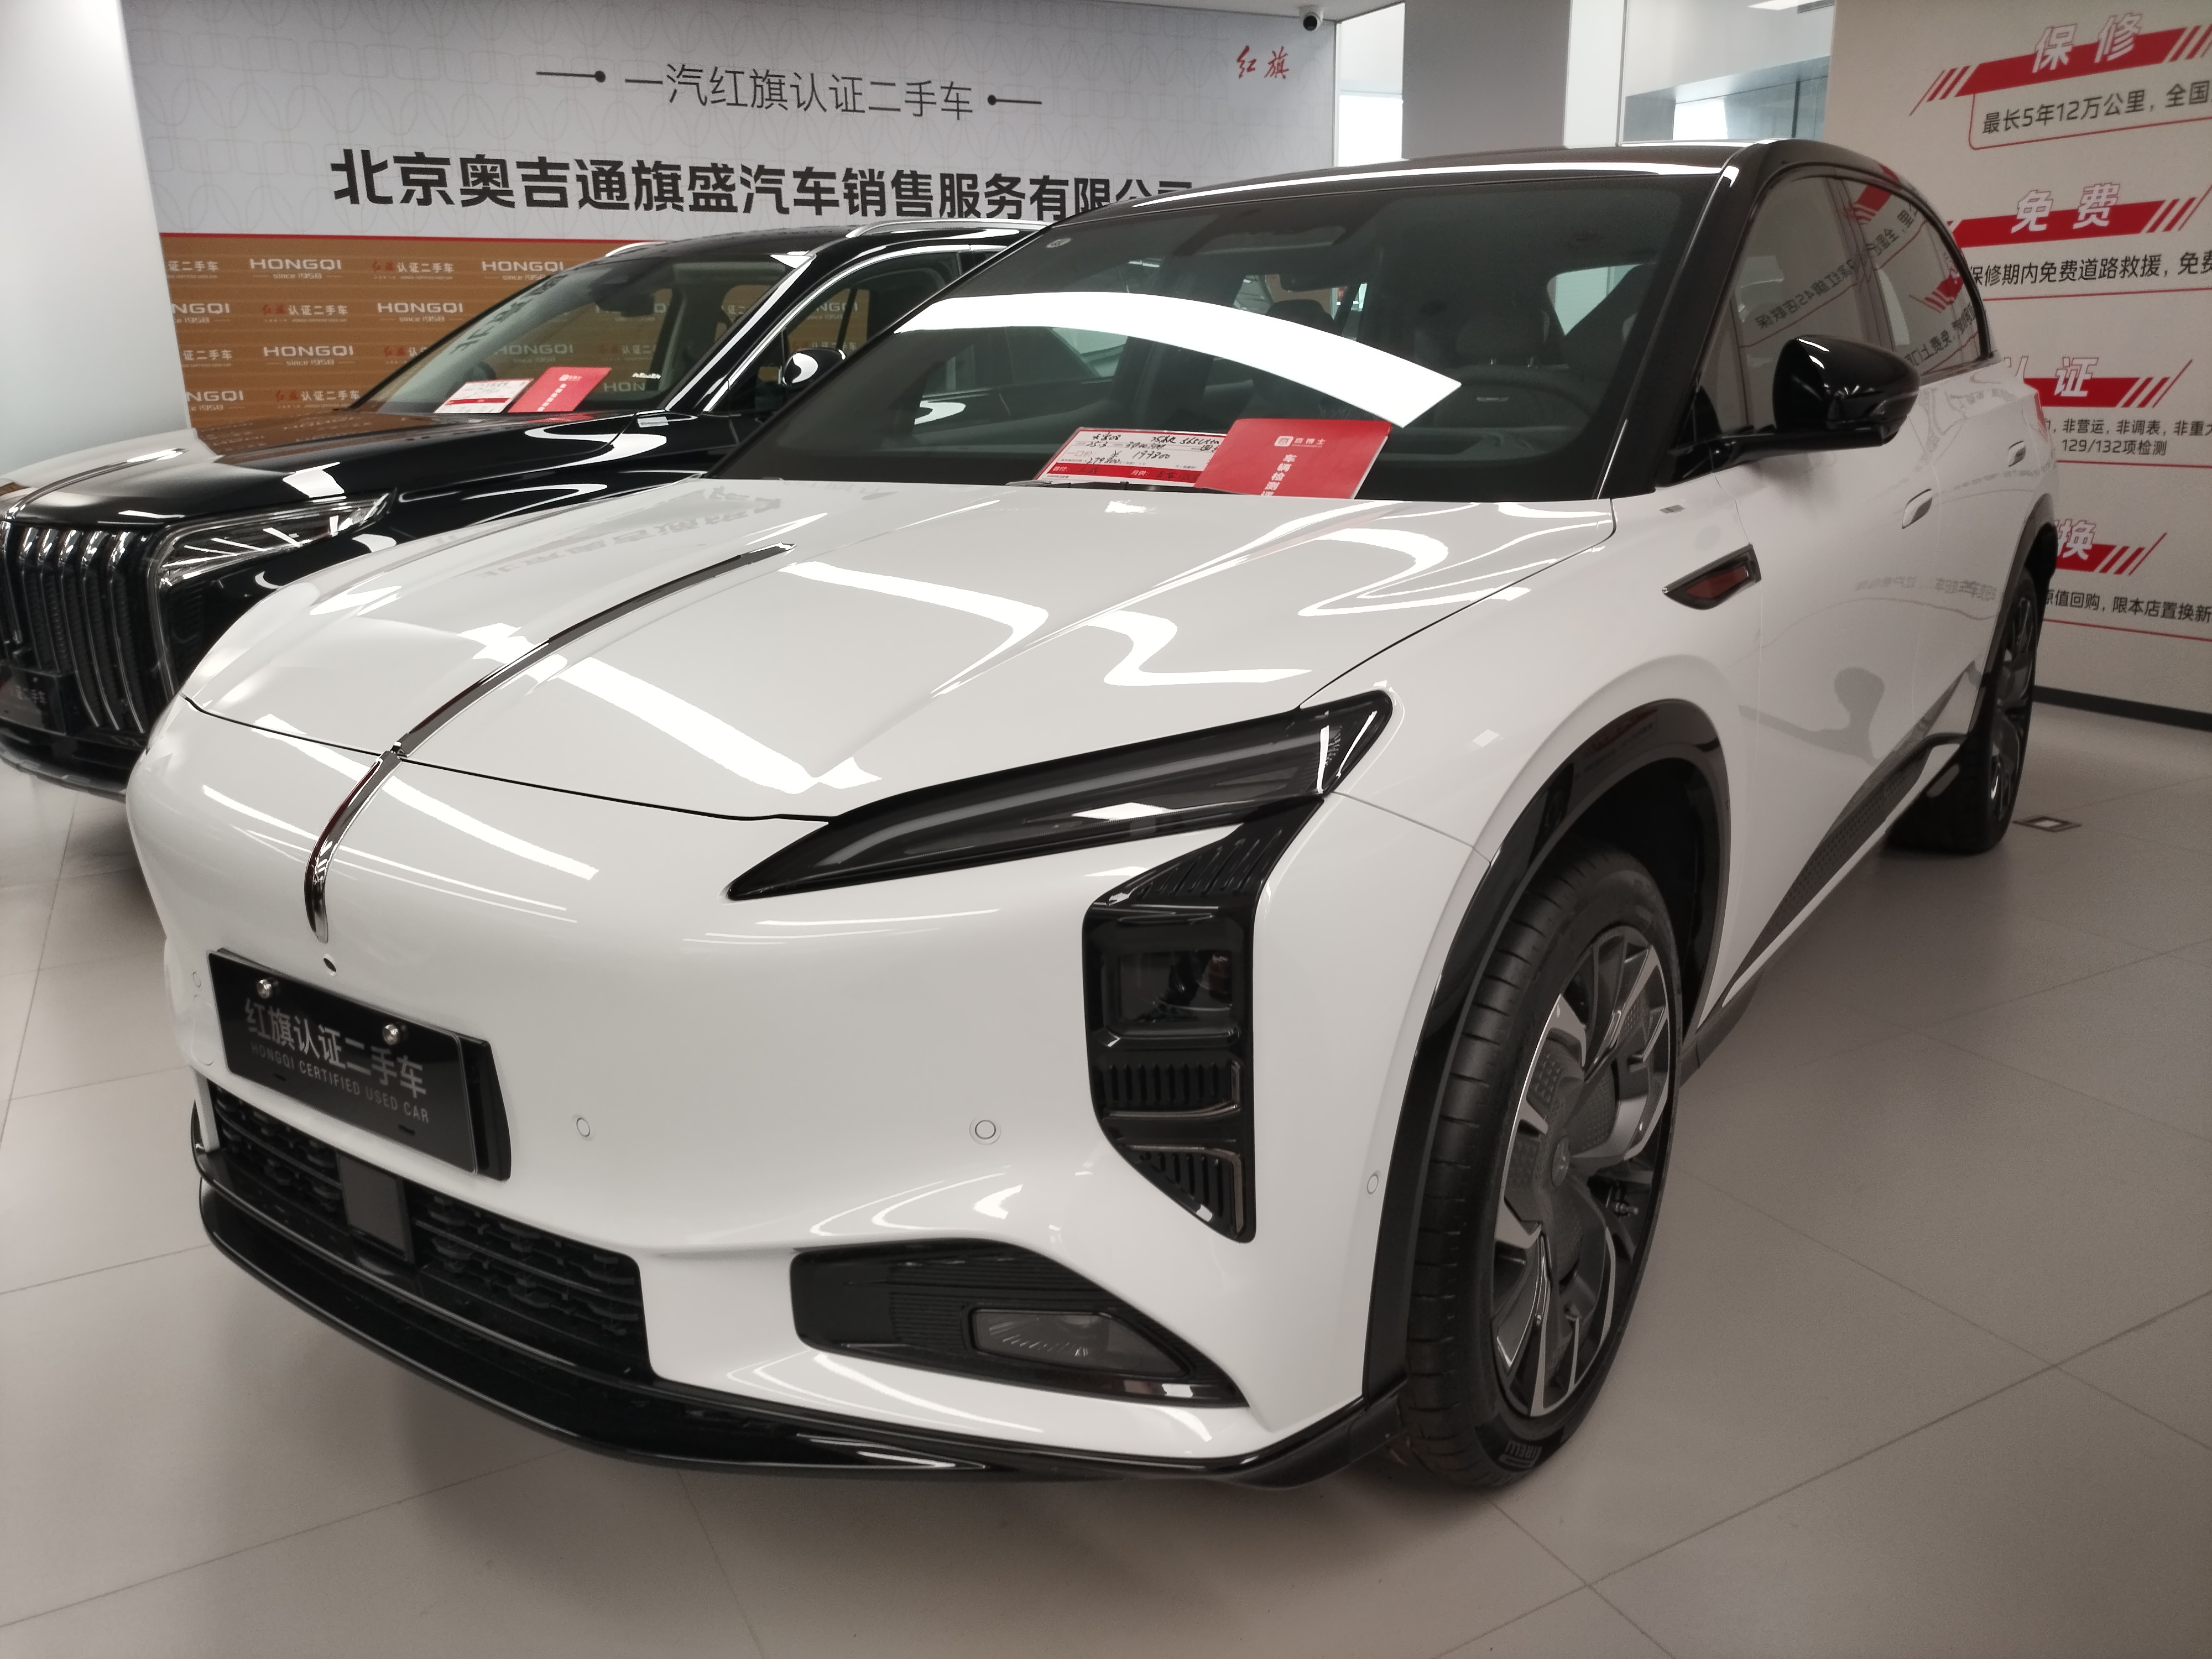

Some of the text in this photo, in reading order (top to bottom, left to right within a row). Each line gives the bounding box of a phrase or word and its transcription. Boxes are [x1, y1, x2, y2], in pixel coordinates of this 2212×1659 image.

[2031, 11, 2143, 74] 保修
[1237, 45, 1289, 80] 红旗
[625, 62, 974, 120] 一汽红旗认证二手车
[1982, 80, 2210, 135] 最长5年12万公里，全国
[2011, 182, 2121, 234] 免费
[250, 258, 342, 270] HONGQI
[482, 260, 564, 272] HONGQI
[377, 302, 464, 314] HONGQI
[263, 345, 354, 357] HONGQI
[2062, 439, 2168, 456] 129/132项检测
[245, 998, 427, 1099] 红旗认证二手车
[251, 1041, 430, 1124] HONGQI CERTIFIED USED CAR
[1498, 1438, 1542, 1469] PIRELLI
